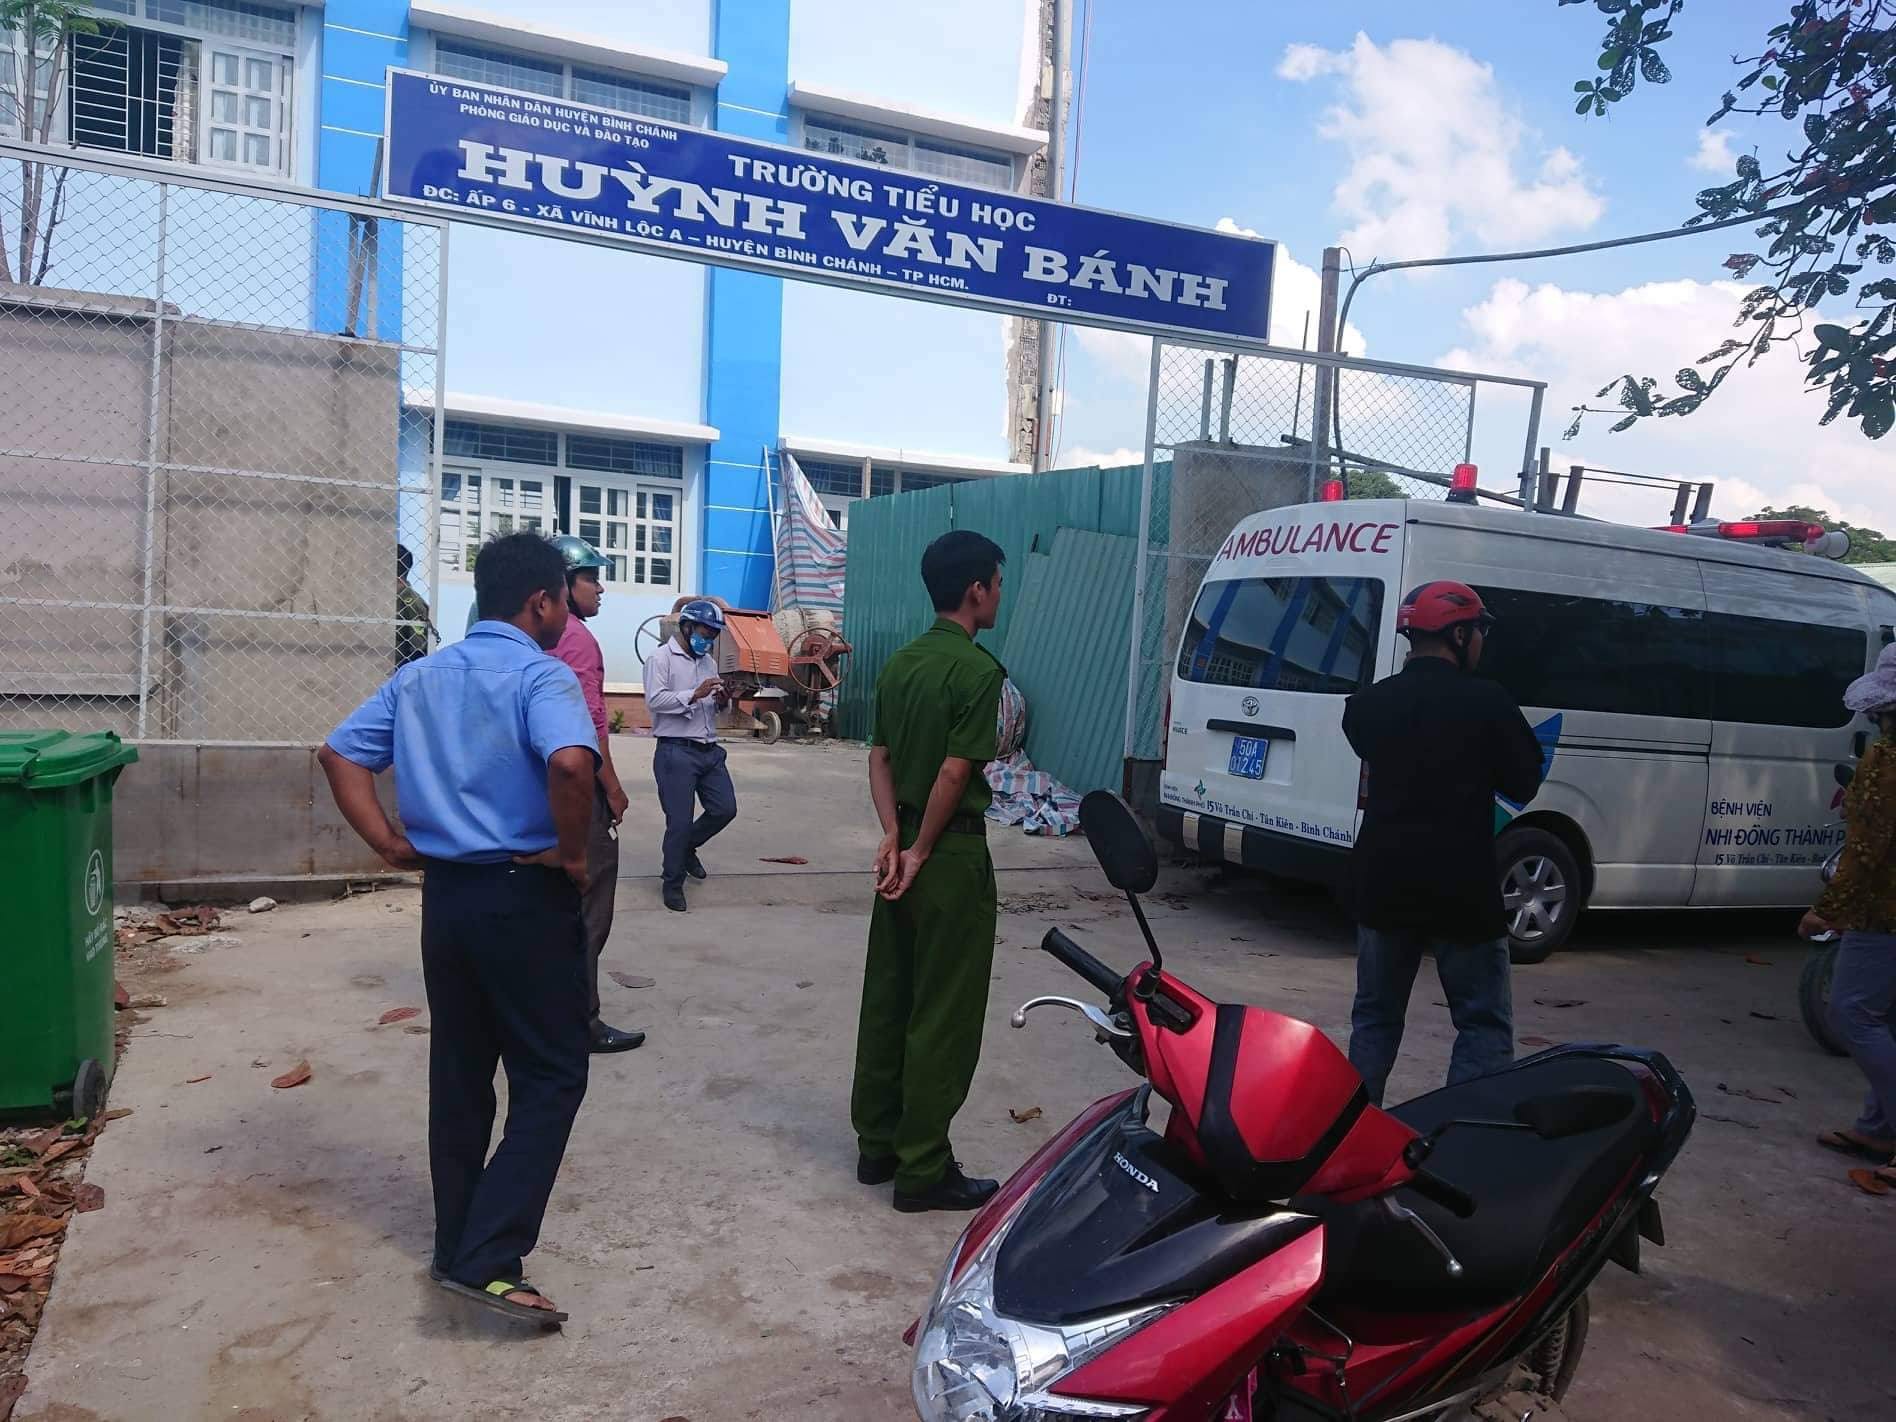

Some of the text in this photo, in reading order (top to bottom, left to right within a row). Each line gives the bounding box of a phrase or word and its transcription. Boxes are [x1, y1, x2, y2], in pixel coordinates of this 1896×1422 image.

[430, 80, 678, 141] ỦY BAN NHÂN DÂN HUYỆN BÌNH CHÁNH
[460, 103, 650, 149] PHÒNG GIÁO DỤC VÀ ĐÀO TẠO
[728, 155, 1036, 232] TRƯỜNG TIỂU HỌC
[423, 184, 459, 202] ĐC:
[466, 189, 497, 208] ẤP
[502, 198, 516, 212] 6
[536, 204, 564, 220] XÃ
[571, 209, 618, 230] VĨNH
[625, 220, 664, 238] LỘC
[668, 228, 682, 241] A
[706, 234, 769, 256] HUYỆN
[775, 245, 818, 265] BÌNH
[823, 255, 882, 276] CHÁNH
[902, 269, 924, 282] TP
[928, 274, 970, 290] HCM.
[458, 140, 1229, 311] HUỲNH VĂN BÁNH
[1047, 293, 1072, 306] ĐT:
[1216, 522, 1400, 562] AMBULANCE
[1240, 740, 1258, 758] 50A
[1207, 800, 1214, 812] 15
[1322, 826, 1353, 842] Chánh
[1711, 798, 1772, 820] BỆNH VIỆN
[1706, 828, 1733, 846] NHI
[1734, 824, 1780, 846] ĐỒNG
[1784, 825, 1834, 846] THÀNH
[1714, 854, 1724, 866] 15
[1113, 1152, 1160, 1192] HONDA
